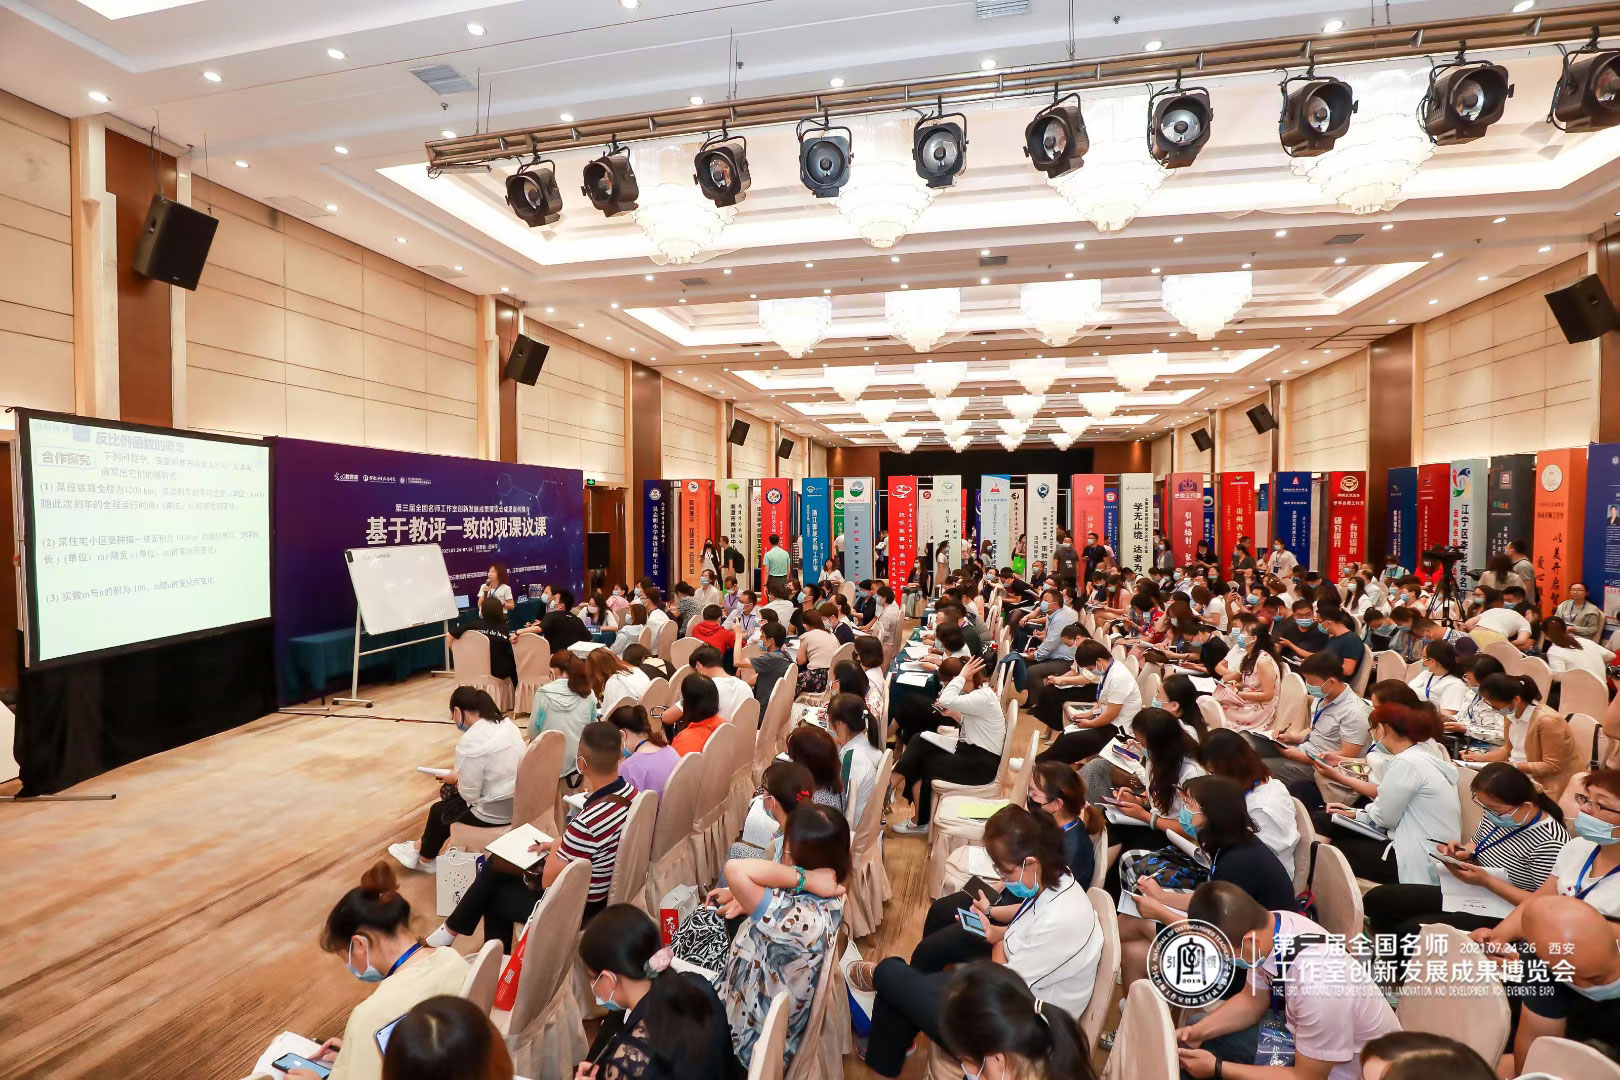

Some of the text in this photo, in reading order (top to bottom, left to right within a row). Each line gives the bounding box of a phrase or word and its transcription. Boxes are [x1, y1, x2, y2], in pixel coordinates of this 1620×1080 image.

[42, 450, 91, 466] 合作探究
[365, 516, 547, 545] 基于教评一致的观课议课
[1133, 502, 1143, 540] 学无止境
